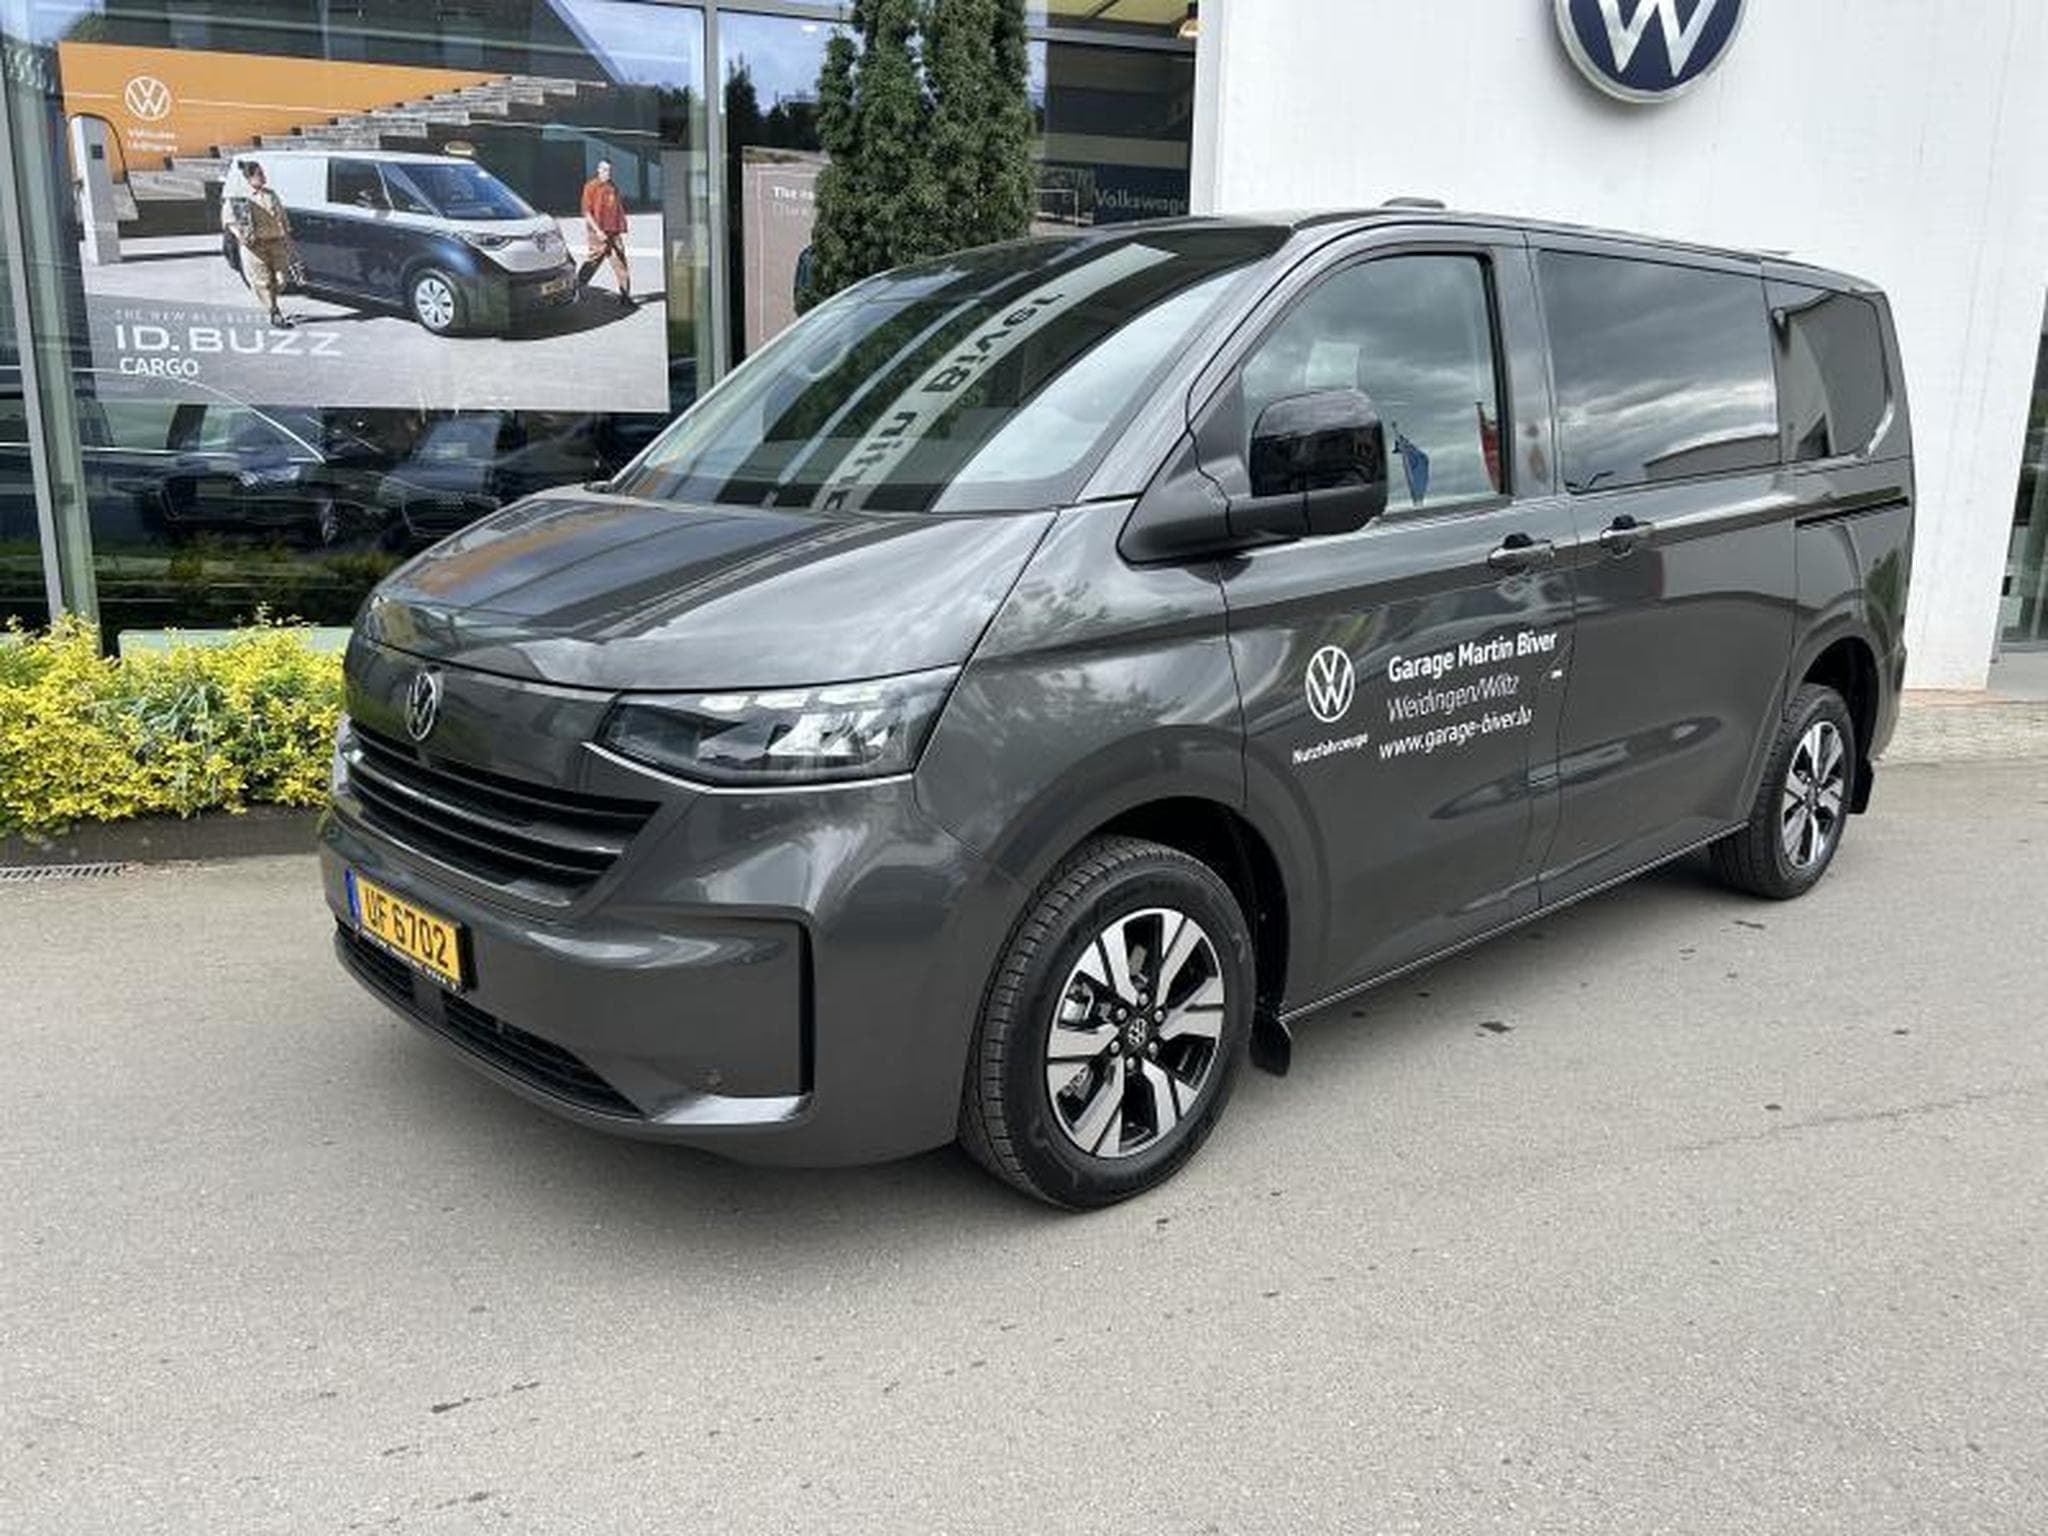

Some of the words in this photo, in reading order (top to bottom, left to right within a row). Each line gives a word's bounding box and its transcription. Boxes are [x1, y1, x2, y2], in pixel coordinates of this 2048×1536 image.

[119, 357, 200, 378] CARGO
[1389, 655, 1455, 682] Garage
[1458, 637, 1515, 668] Martin
[1517, 630, 1557, 656] Biver
[1292, 730, 1369, 764] Nutzfahrzeuge
[1379, 704, 1533, 759] www.garage-biver.lu
[365, 887, 388, 932] UF
[392, 902, 449, 969] 6702
